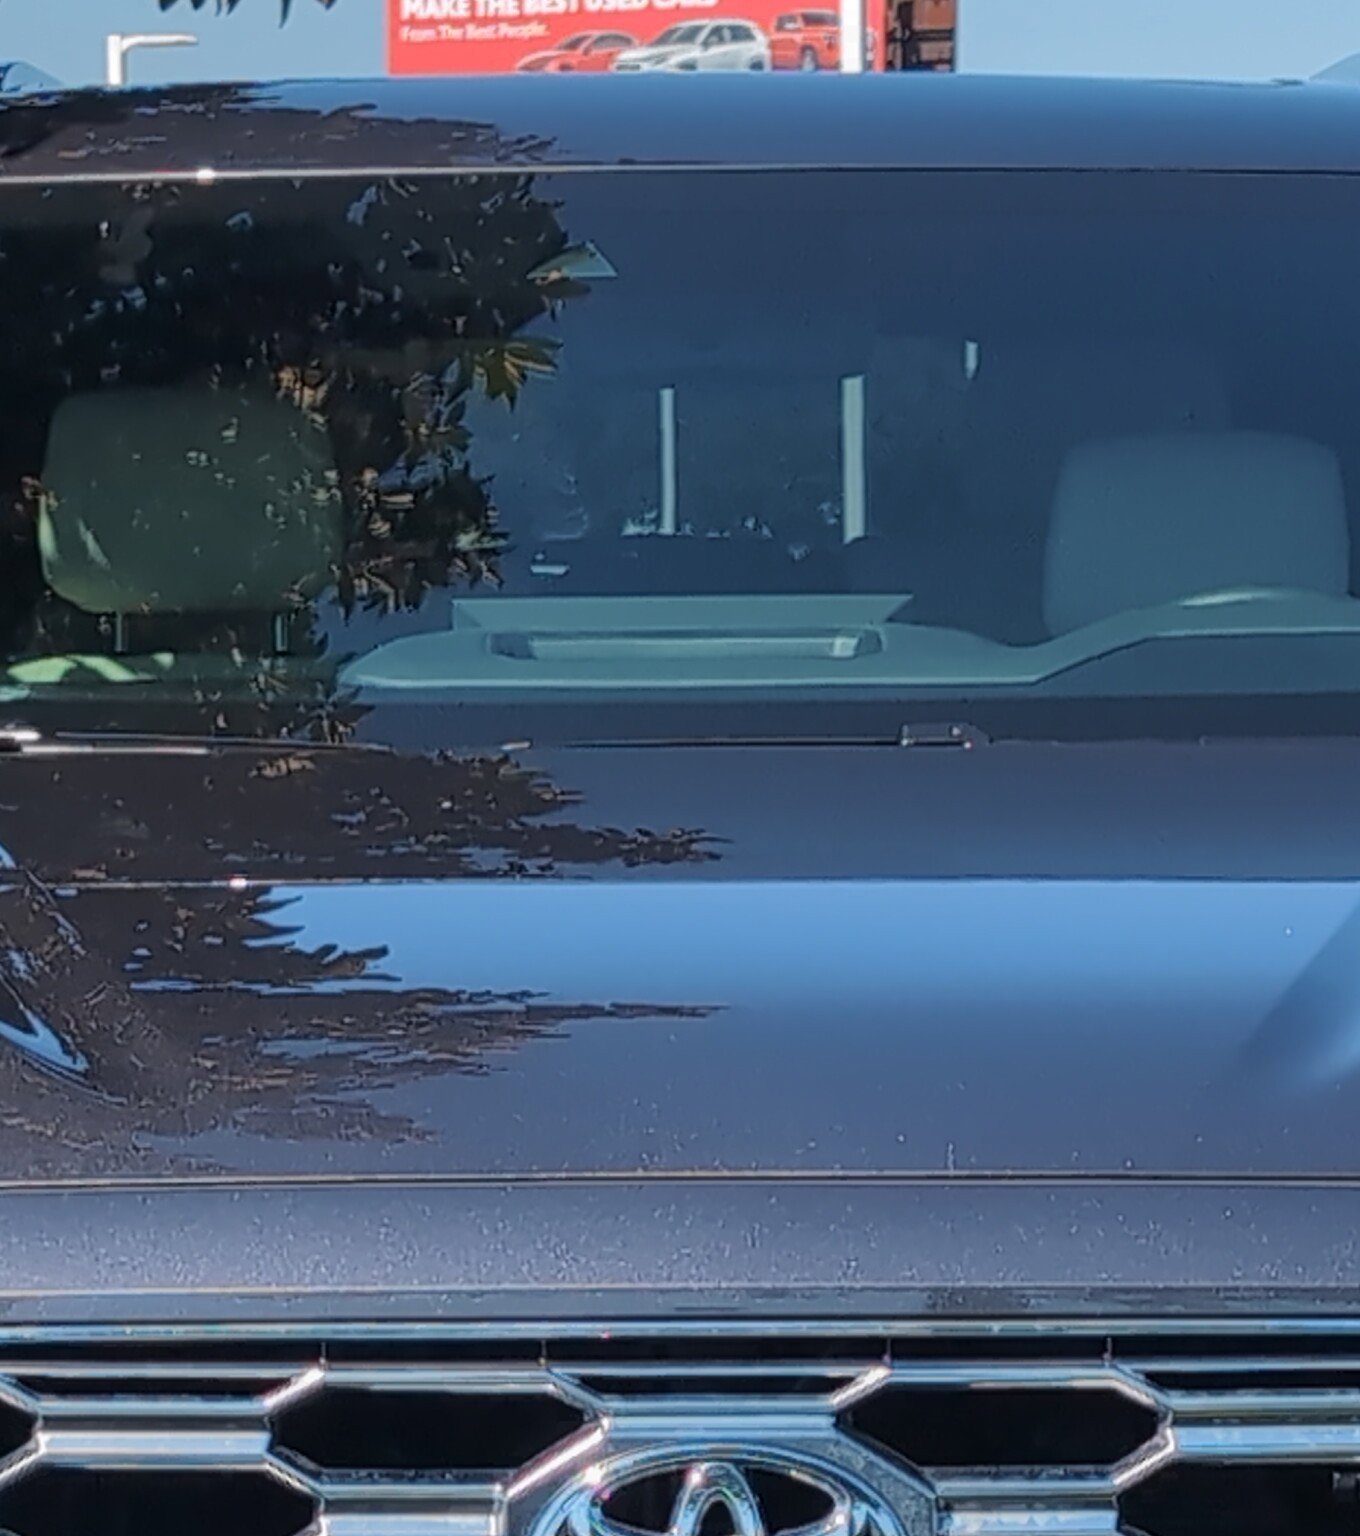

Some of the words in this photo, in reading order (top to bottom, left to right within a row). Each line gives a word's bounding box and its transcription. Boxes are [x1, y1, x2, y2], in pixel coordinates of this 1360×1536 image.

[400, 0, 471, 19] MAKE
[475, 0, 520, 17] THE
[522, 0, 578, 15] BEST
